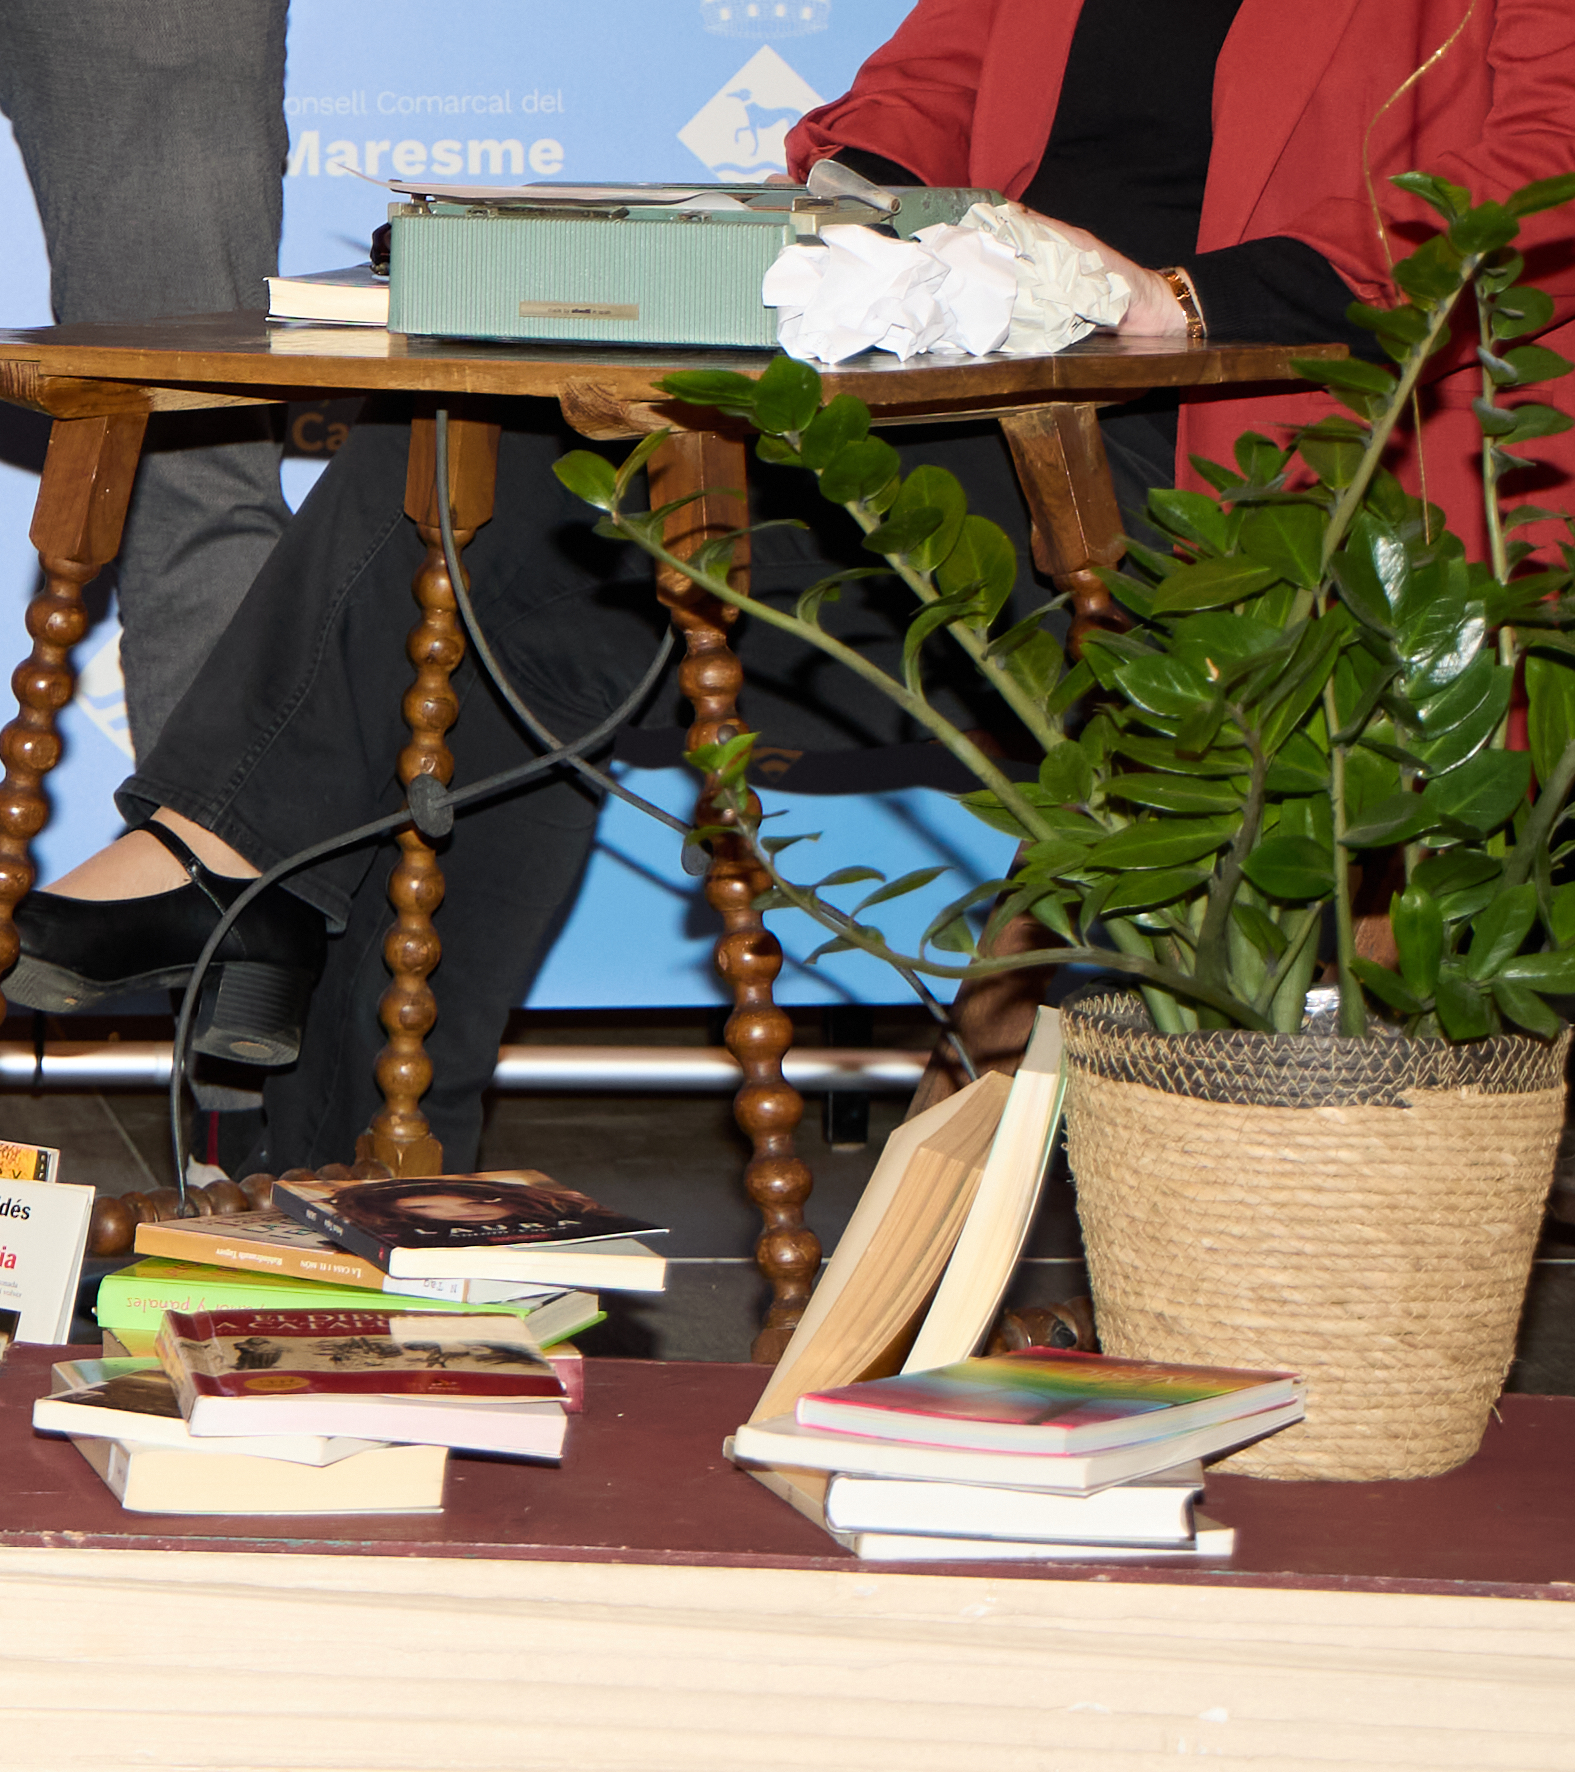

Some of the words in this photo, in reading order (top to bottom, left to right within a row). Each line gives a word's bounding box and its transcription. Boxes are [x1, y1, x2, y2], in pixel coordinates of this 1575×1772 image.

[285, 90, 367, 115] onsell
[376, 90, 512, 116] Comarcal
[521, 89, 564, 114] del
[288, 131, 564, 177] Maresme
